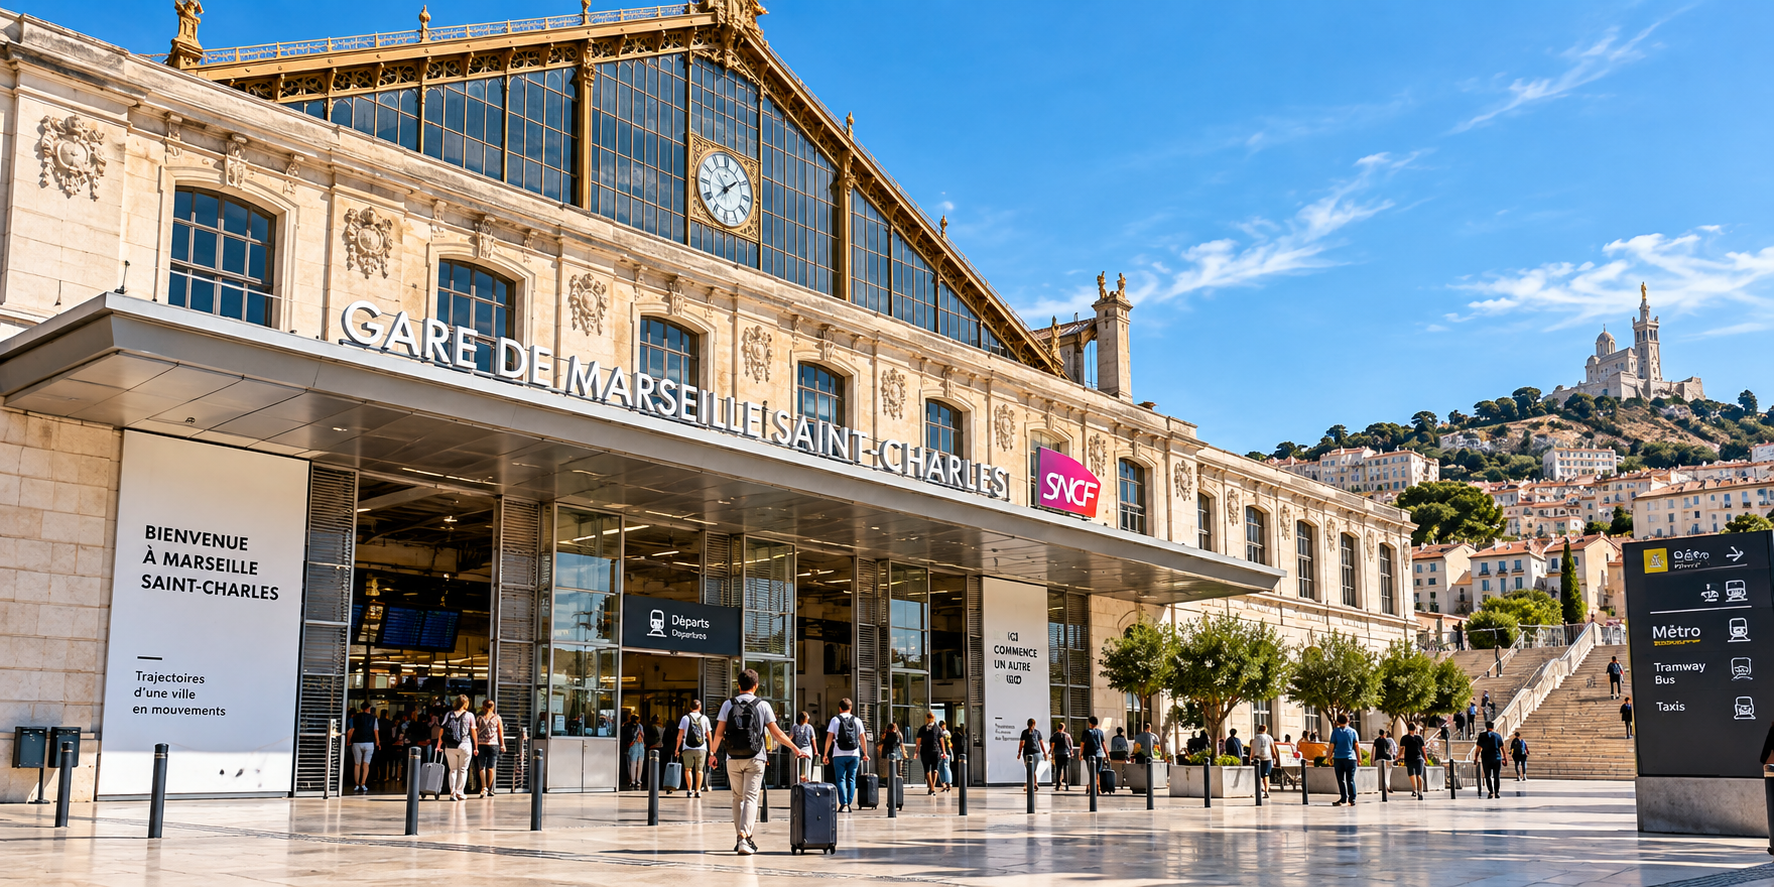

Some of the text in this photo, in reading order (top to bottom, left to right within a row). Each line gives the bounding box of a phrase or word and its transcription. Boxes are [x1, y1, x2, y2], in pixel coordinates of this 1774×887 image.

[341, 299, 1008, 499] GARE DE MARSEILLE SAINT-CHARLES
[1043, 471, 1099, 508] SNCF
[145, 525, 248, 551] BIENVENUE
[142, 544, 258, 576] À MARSEILLE
[141, 574, 279, 601] SAINT-CHARLES
[671, 614, 710, 630] Départs
[993, 645, 1038, 659] COMMENCE
[994, 660, 1031, 672] UN AUTRE
[1653, 662, 1706, 673] Tramway
[135, 670, 205, 685] Trajectoires
[1655, 675, 1676, 685] Bus
[171, 688, 196, 700] ville
[132, 705, 226, 717] en mouvements
[1656, 701, 1686, 712] Taxis
